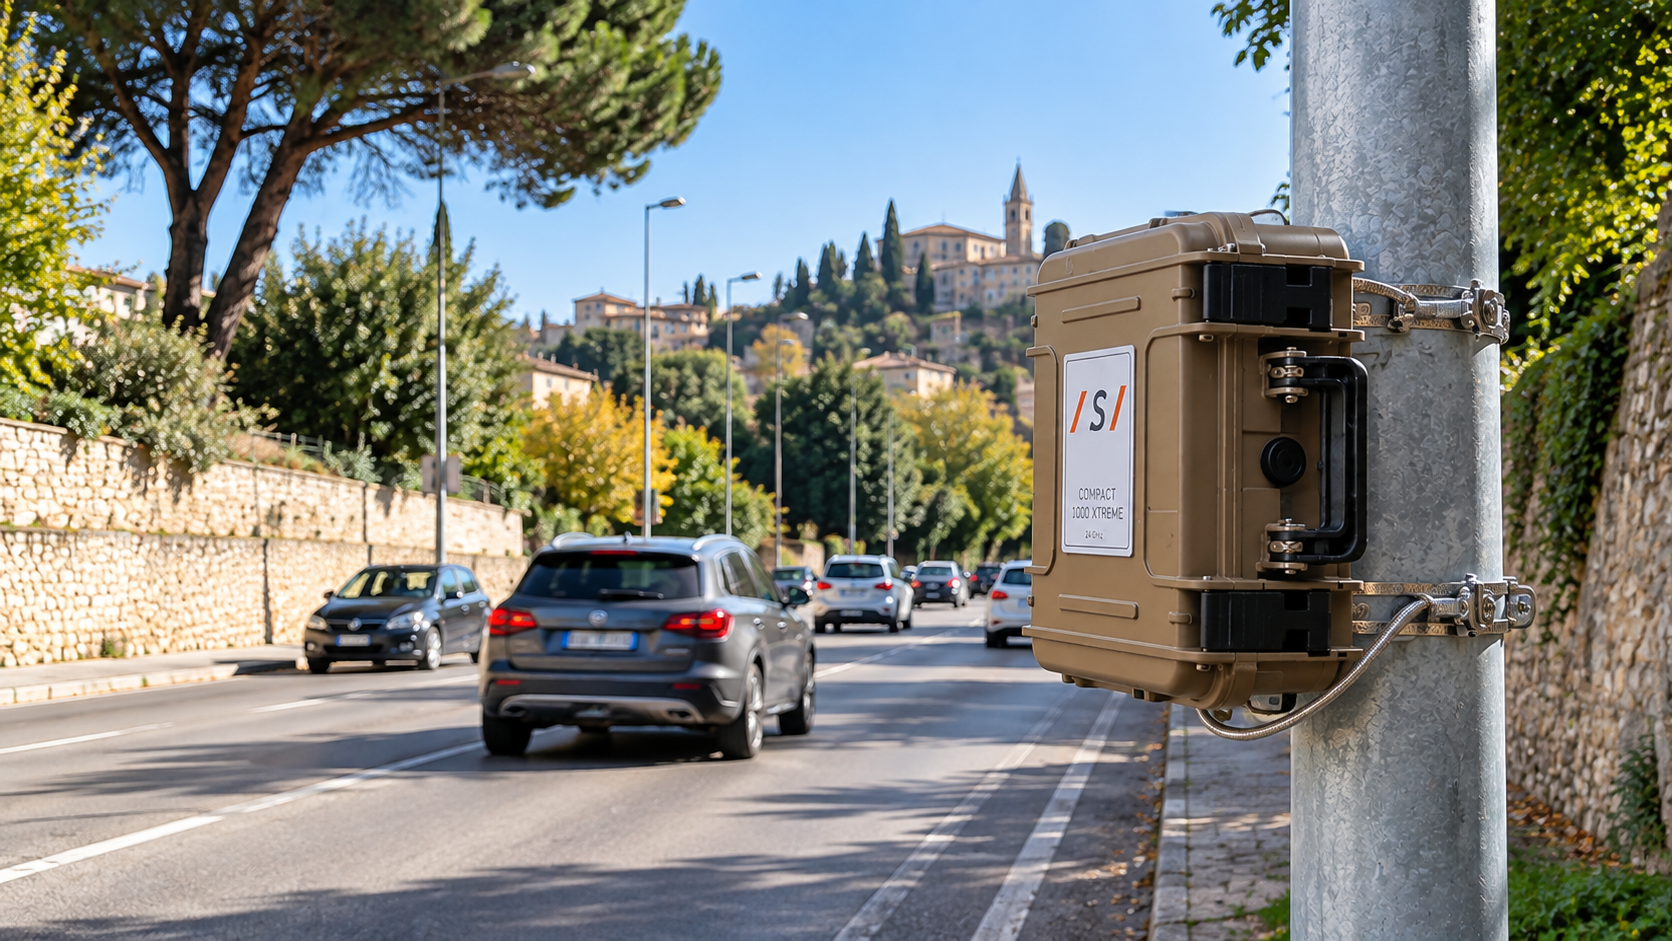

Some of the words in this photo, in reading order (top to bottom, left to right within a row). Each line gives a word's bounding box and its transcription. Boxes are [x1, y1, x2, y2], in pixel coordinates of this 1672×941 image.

[1078, 487, 1116, 501] COMPACT
[1072, 506, 1090, 519] 1000
[1091, 506, 1124, 520] XTREME
